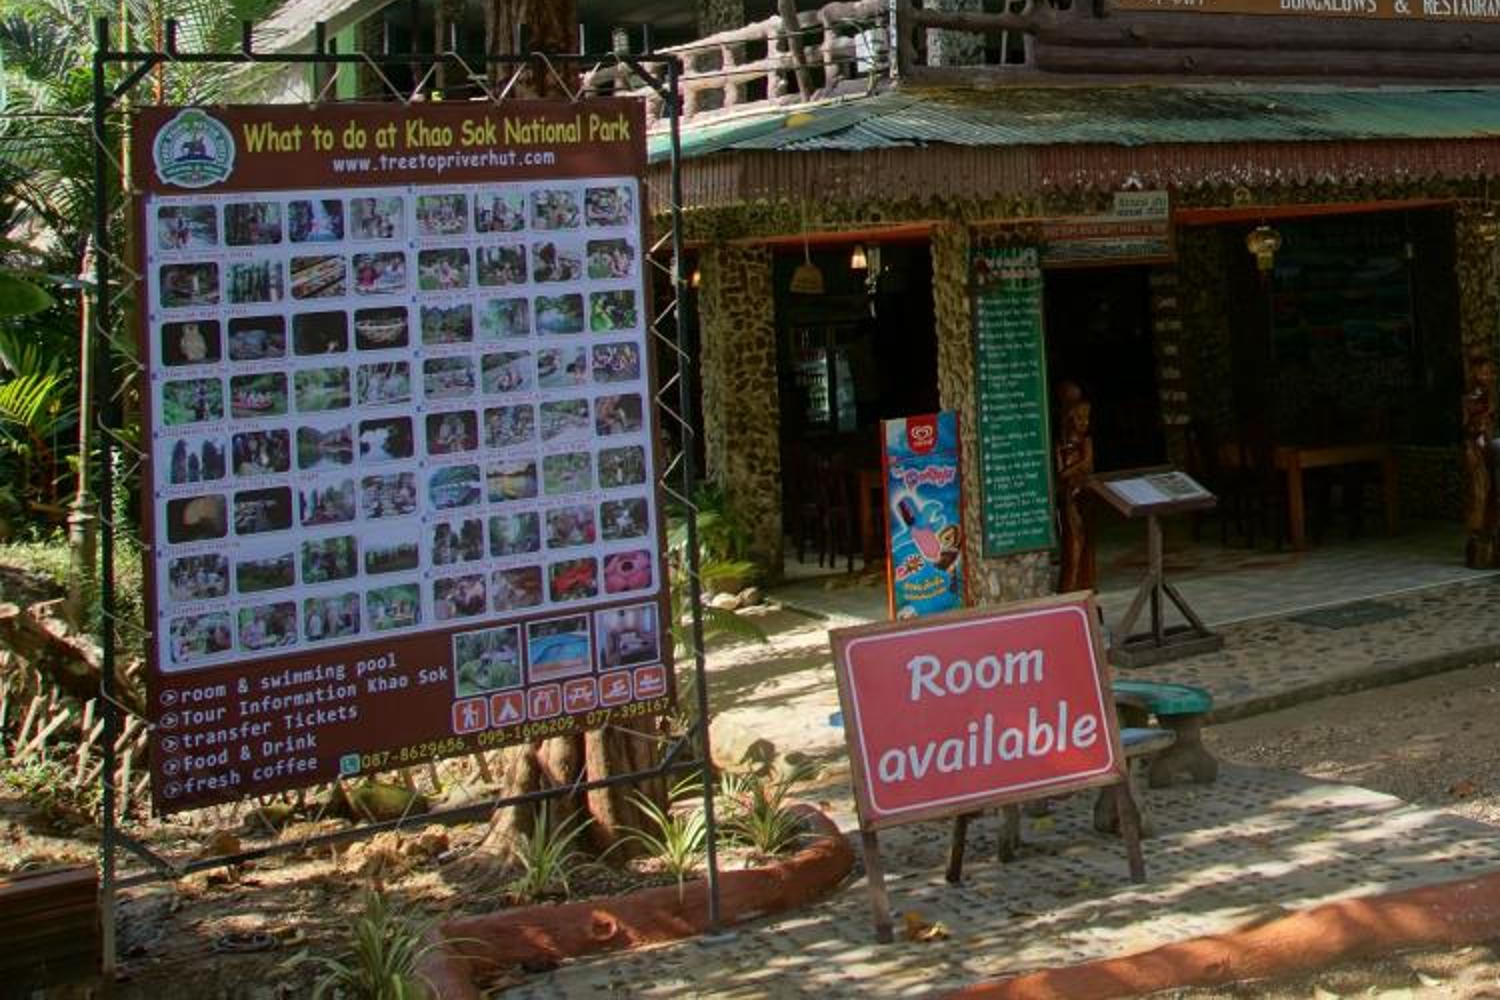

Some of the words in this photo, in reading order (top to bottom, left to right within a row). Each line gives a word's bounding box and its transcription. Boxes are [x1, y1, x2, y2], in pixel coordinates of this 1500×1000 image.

[243, 122, 303, 153] What
[312, 123, 334, 150] to
[342, 119, 367, 149] do
[375, 121, 397, 149] at
[406, 117, 454, 148] Khao
[461, 115, 497, 146] Sok
[504, 114, 581, 145] National
[589, 112, 631, 142] Park
[332, 150, 556, 174] www.treetopriverhut.com
[181, 684, 227, 703] room
[237, 677, 249, 693] &
[260, 660, 346, 690] swimming
[356, 652, 397, 676] pool
[182, 706, 227, 725] Tour
[239, 682, 358, 716] Information
[368, 671, 408, 693] Khao
[419, 665, 449, 684] Sok
[907, 648, 1043, 701] Room
[182, 719, 273, 749] transfer
[284, 704, 359, 730] Tickets
[239, 745, 252, 762] &
[262, 733, 318, 758] Drink
[878, 700, 1098, 783] available
[183, 766, 242, 793] fresh
[252, 756, 319, 782] coffee
